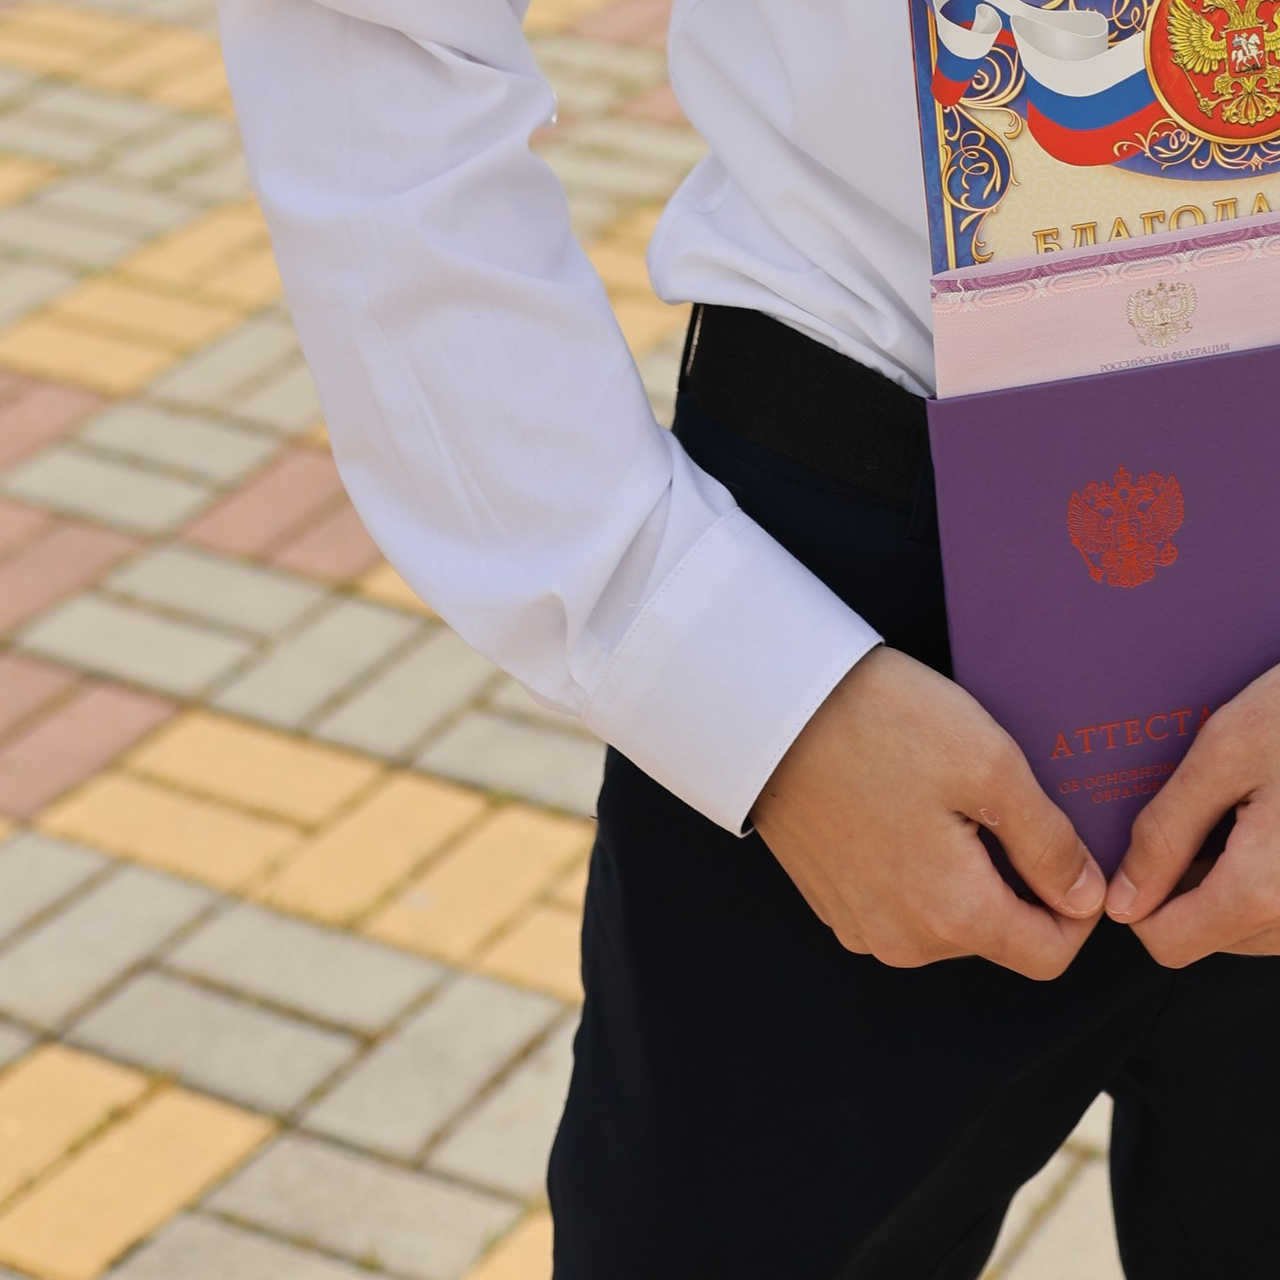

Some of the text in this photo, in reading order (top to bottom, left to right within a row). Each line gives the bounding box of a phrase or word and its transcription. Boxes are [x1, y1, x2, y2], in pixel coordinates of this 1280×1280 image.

[1100, 342, 1230, 373] РОССИЙСКАЯ ФЕДЕРАЦИЯ
[1051, 702, 1223, 760] АТТЕСТА
[1058, 780, 1080, 794] ОБ
[1091, 779, 1165, 804] ОБРАЗОВ
